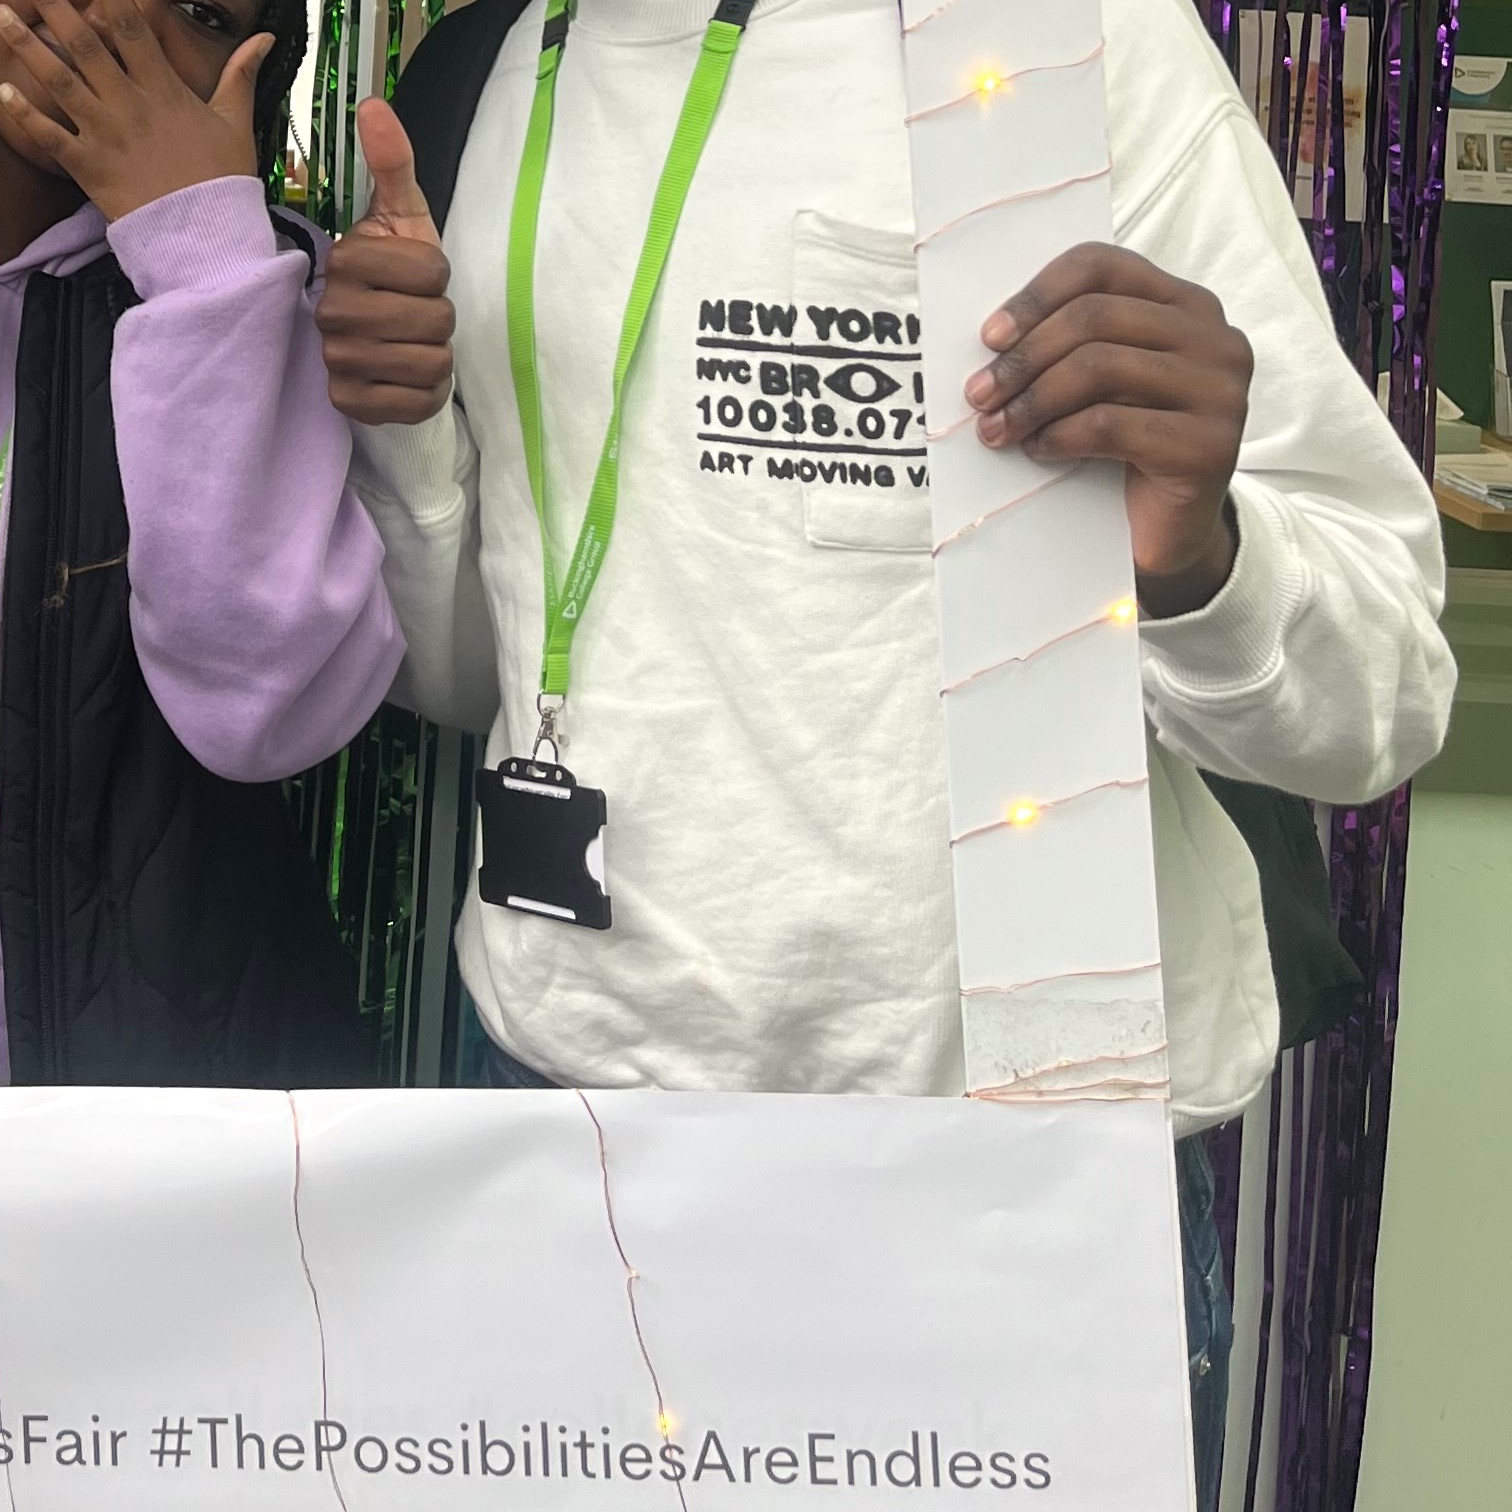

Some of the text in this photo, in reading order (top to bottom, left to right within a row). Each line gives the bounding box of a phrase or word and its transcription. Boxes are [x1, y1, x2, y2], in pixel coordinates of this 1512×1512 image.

[699, 299, 798, 338] NEW
[696, 356, 752, 385] NYC
[695, 395, 926, 440] 10038.07
[699, 449, 930, 488] ART MOVING V
[148, 1412, 1052, 1490] #ThePossibilitiesAreEndless
